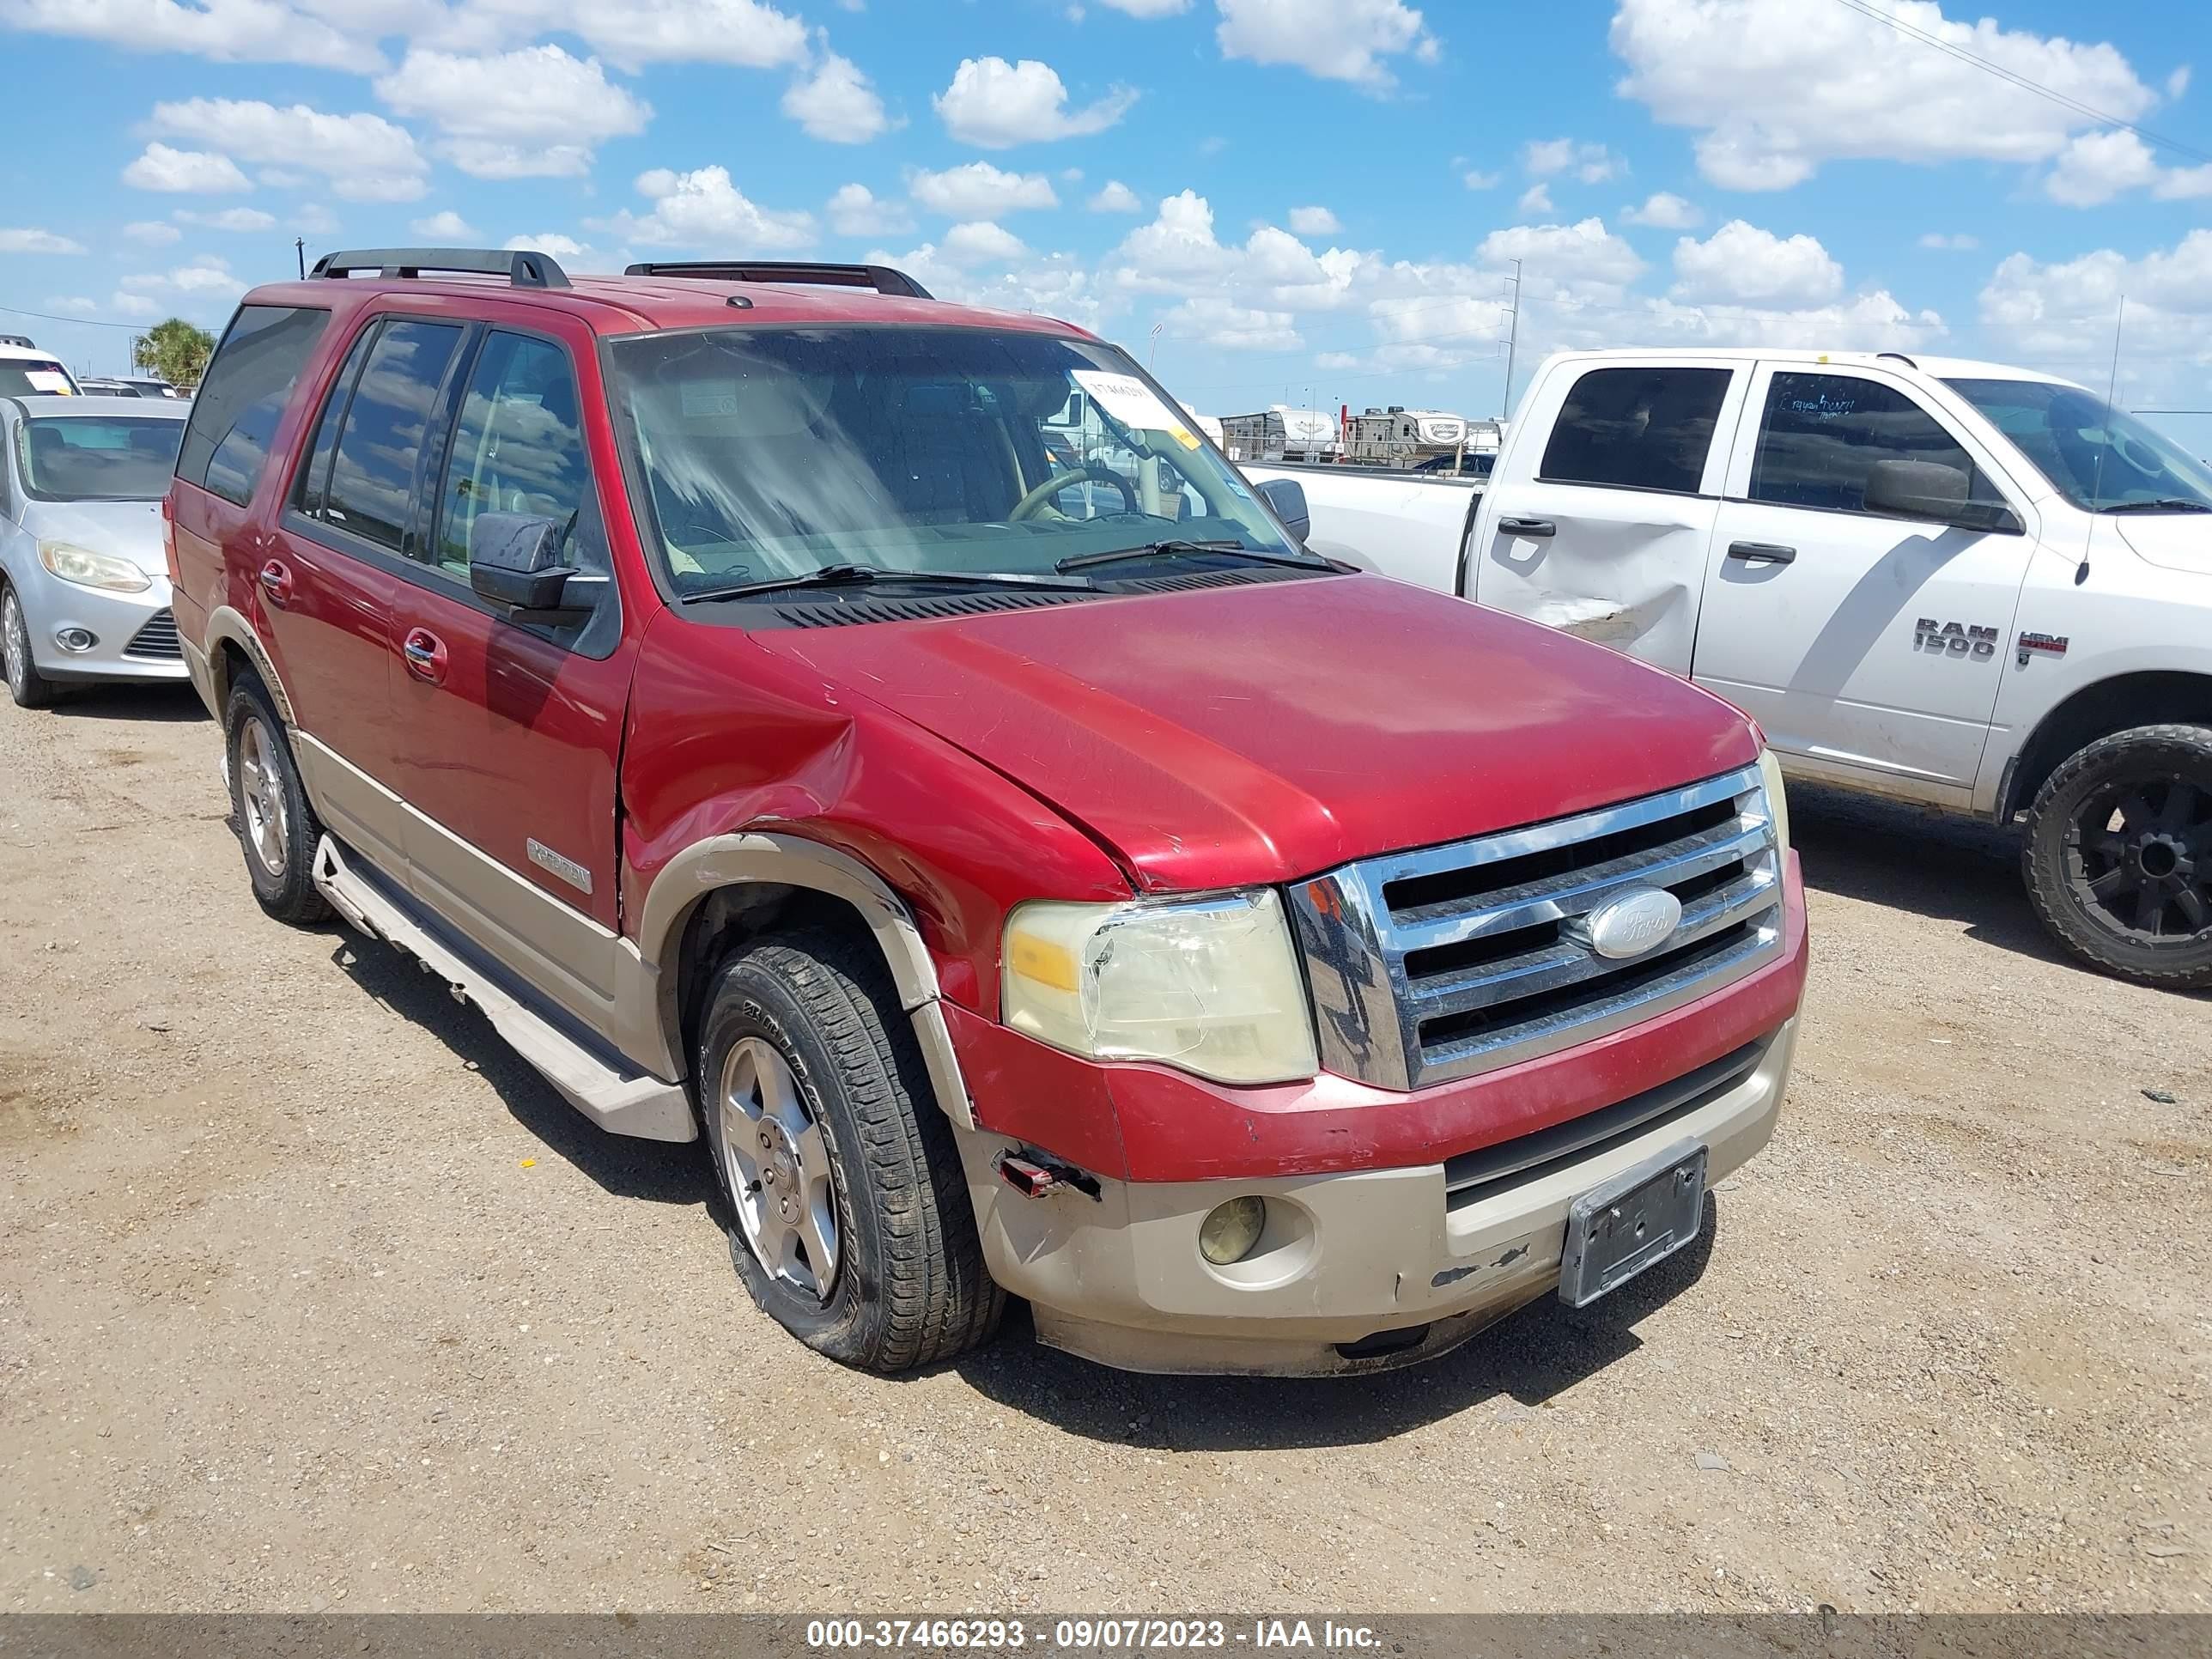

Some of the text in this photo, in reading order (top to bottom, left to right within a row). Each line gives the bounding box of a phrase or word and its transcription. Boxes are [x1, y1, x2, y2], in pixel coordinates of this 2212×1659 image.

[1916, 617, 2000, 640] RAM
[2020, 631, 2069, 646] HEMI
[1915, 633, 1996, 657] 1500
[1622, 904, 1669, 942] Ford
